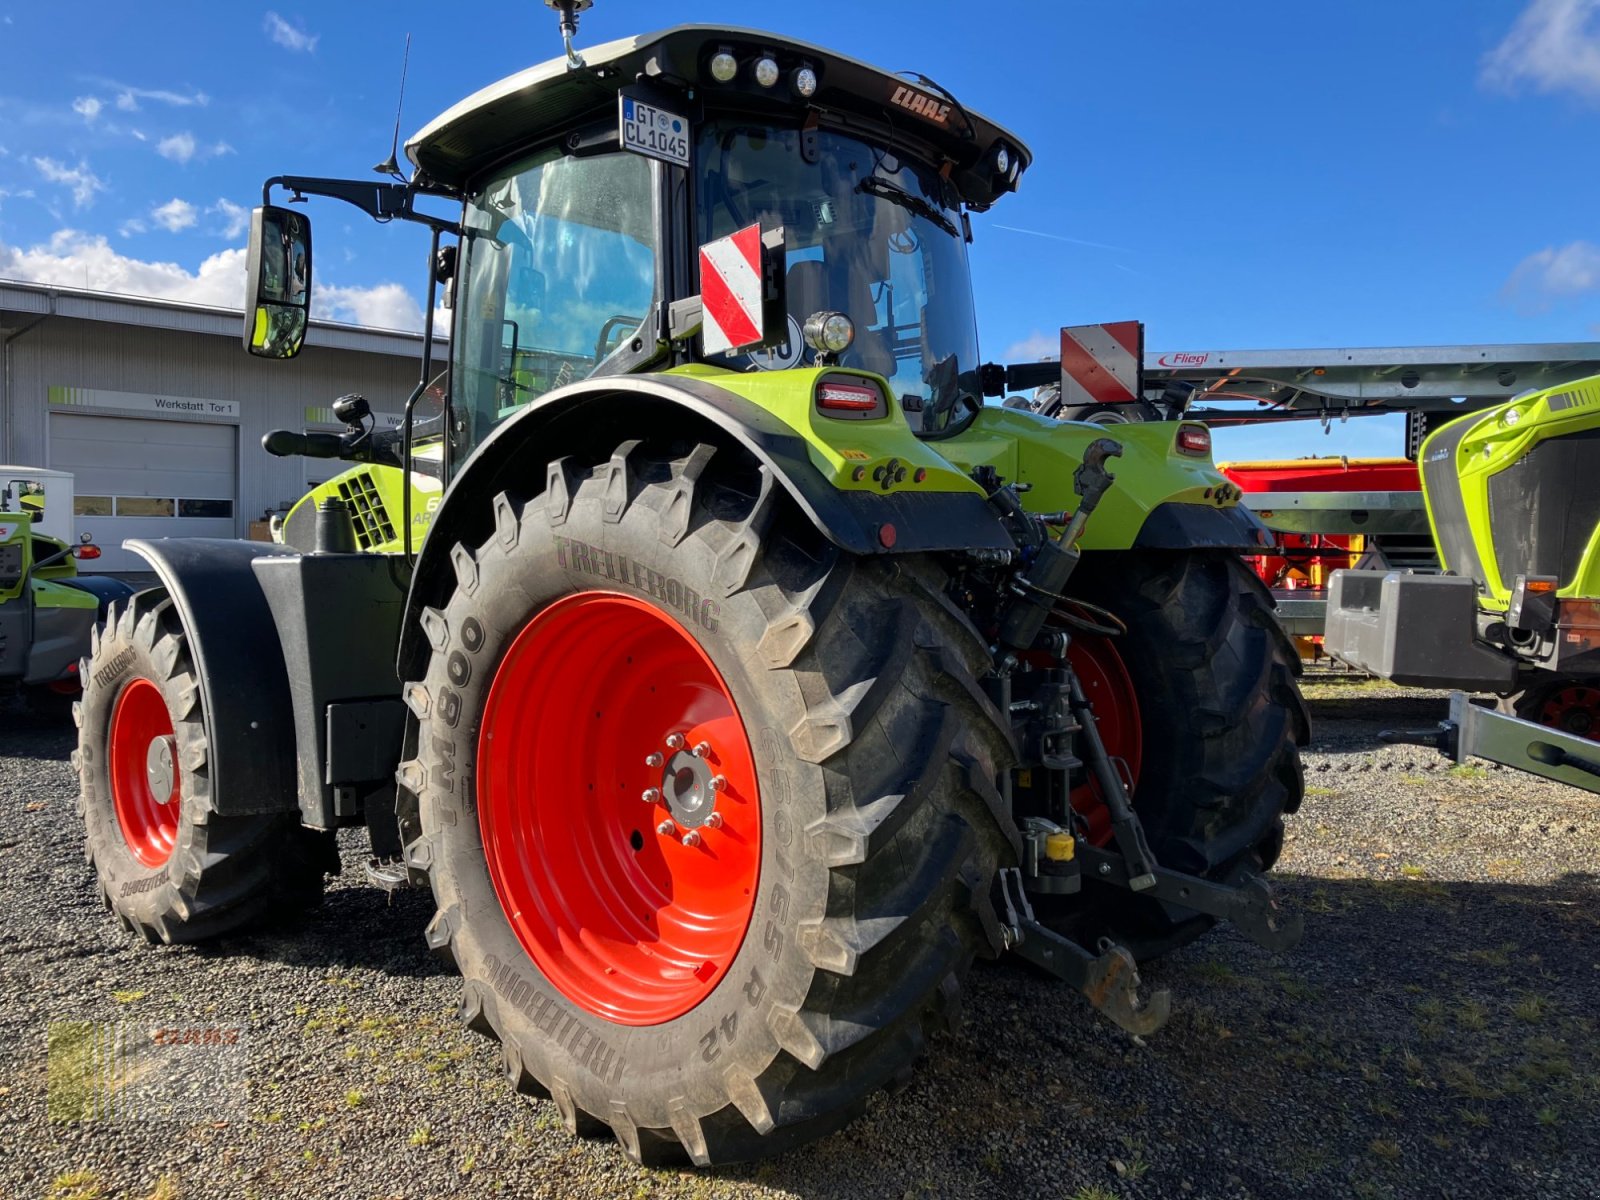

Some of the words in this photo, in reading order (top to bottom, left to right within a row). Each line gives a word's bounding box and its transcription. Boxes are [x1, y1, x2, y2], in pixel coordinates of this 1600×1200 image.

[636, 104, 657, 127] GT
[891, 86, 951, 123] CLAAS
[625, 121, 687, 158] CL1045
[1173, 352, 1209, 365] Fliegl
[155, 398, 204, 412] Werkstatt
[209, 402, 226, 413] Tor
[227, 404, 232, 413] 1
[412, 512, 437, 525] AR
[553, 536, 722, 635] TRELLEBORG
[94, 645, 137, 689] TRELLEBORG
[436, 615, 486, 729] 800
[120, 867, 171, 898] TRELLEBORG
[742, 966, 768, 1009] R
[479, 953, 629, 1086] TRELLEBORG
[701, 1016, 738, 1064] 42
